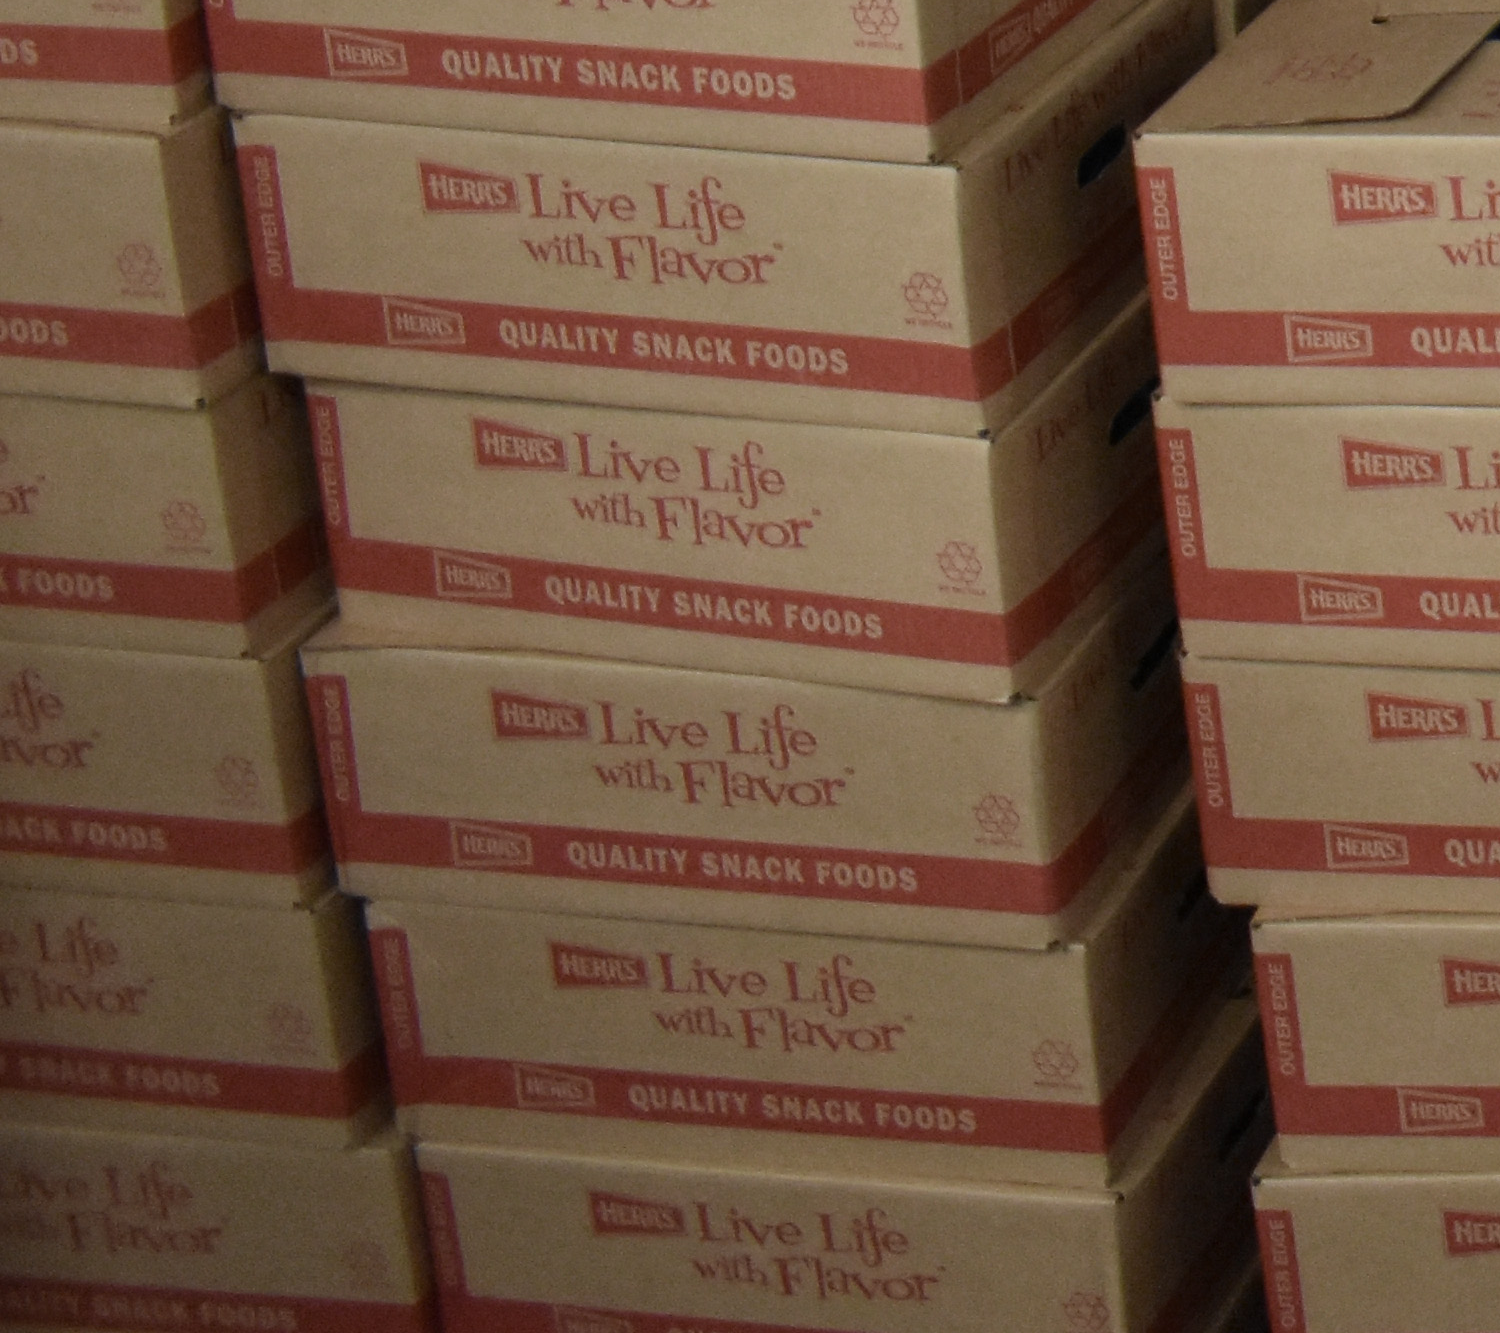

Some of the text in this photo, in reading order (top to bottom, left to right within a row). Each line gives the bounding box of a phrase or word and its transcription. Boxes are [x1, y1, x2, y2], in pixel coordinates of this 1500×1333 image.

[655, 951, 766, 997] Live
[785, 954, 876, 1017] Life
[653, 1007, 904, 1053] with Flavor
[629, 1083, 747, 1115] QUALITY
[762, 1093, 864, 1126] SNACK
[875, 1102, 976, 1133] FOODS
